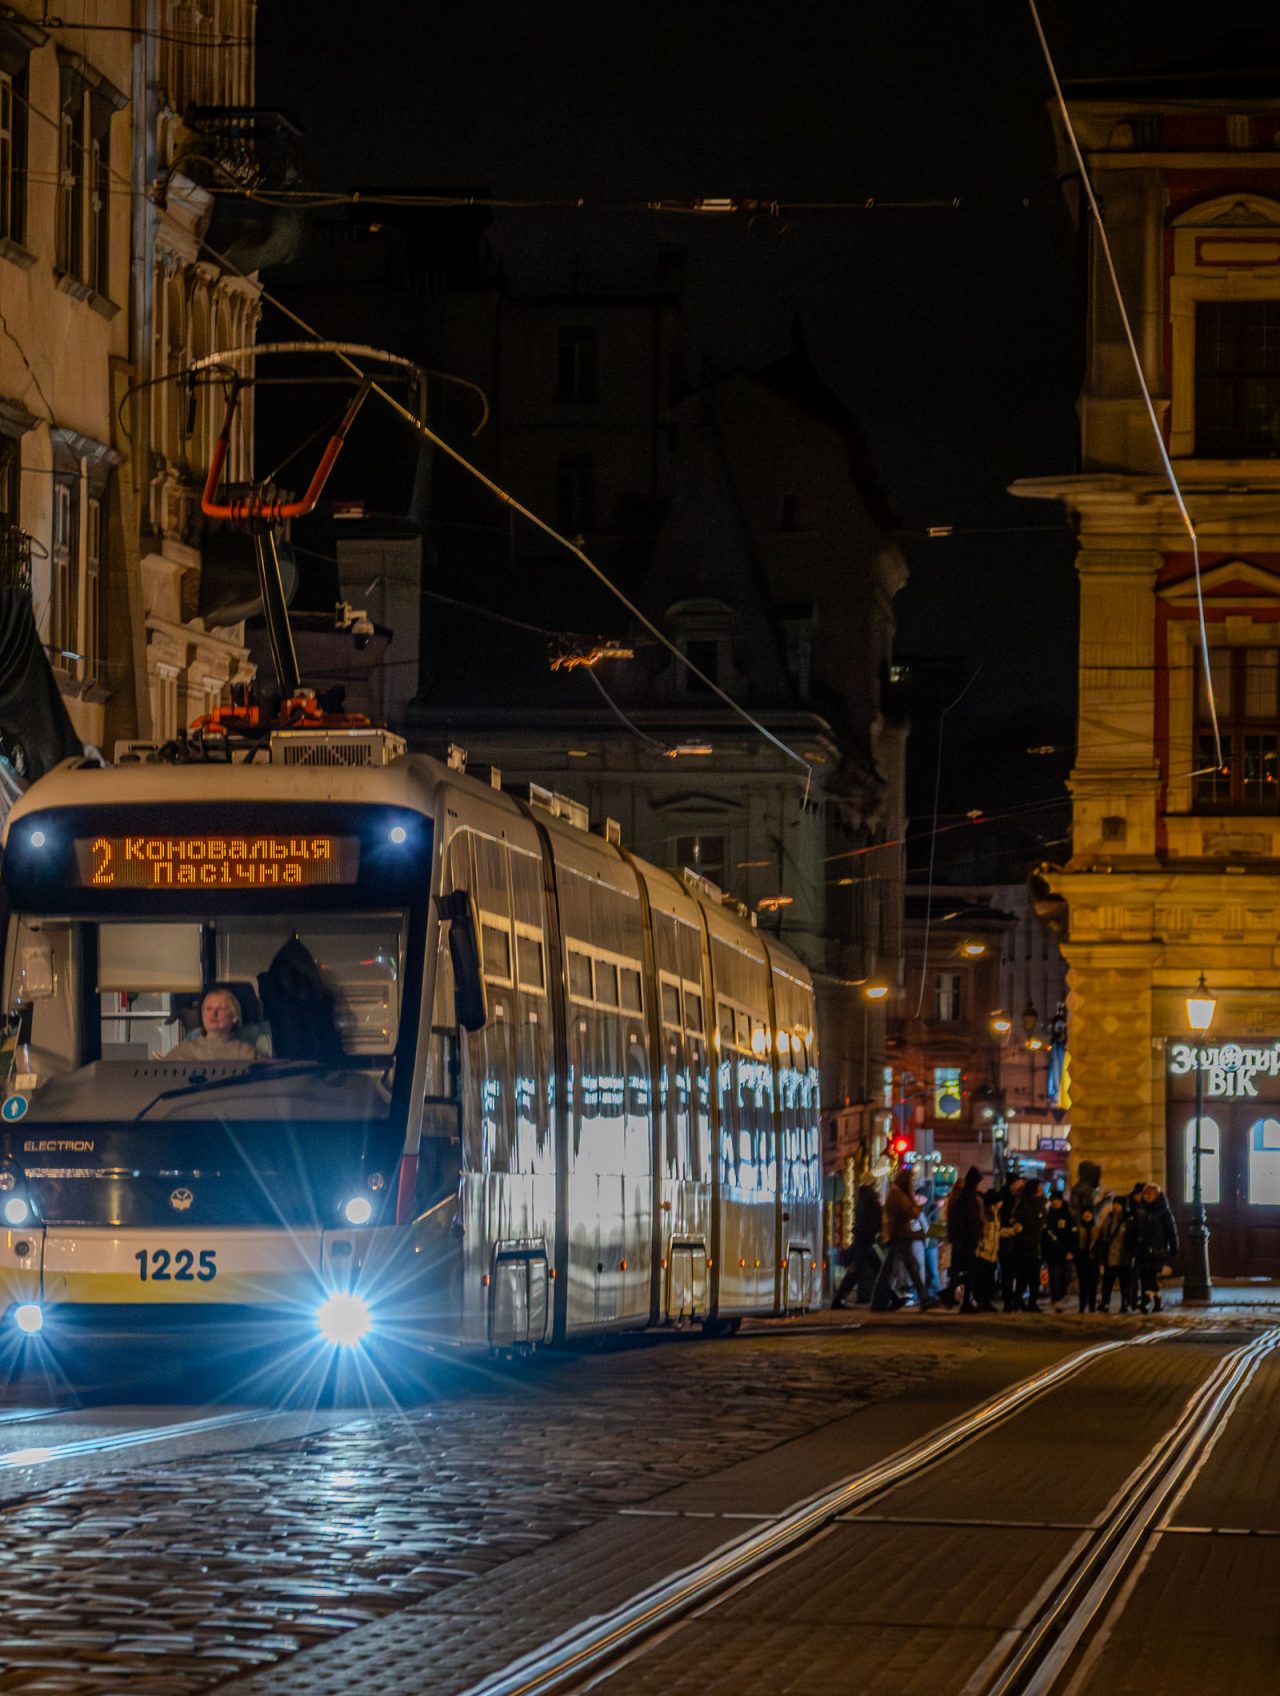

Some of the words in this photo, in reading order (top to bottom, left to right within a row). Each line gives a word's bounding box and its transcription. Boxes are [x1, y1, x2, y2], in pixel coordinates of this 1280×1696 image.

[125, 838, 330, 860] Коновальця
[92, 837, 114, 884] 2
[154, 861, 302, 883] Пасічна
[23, 1139, 95, 1152] ELECTRON
[135, 1248, 217, 1282] 1225
